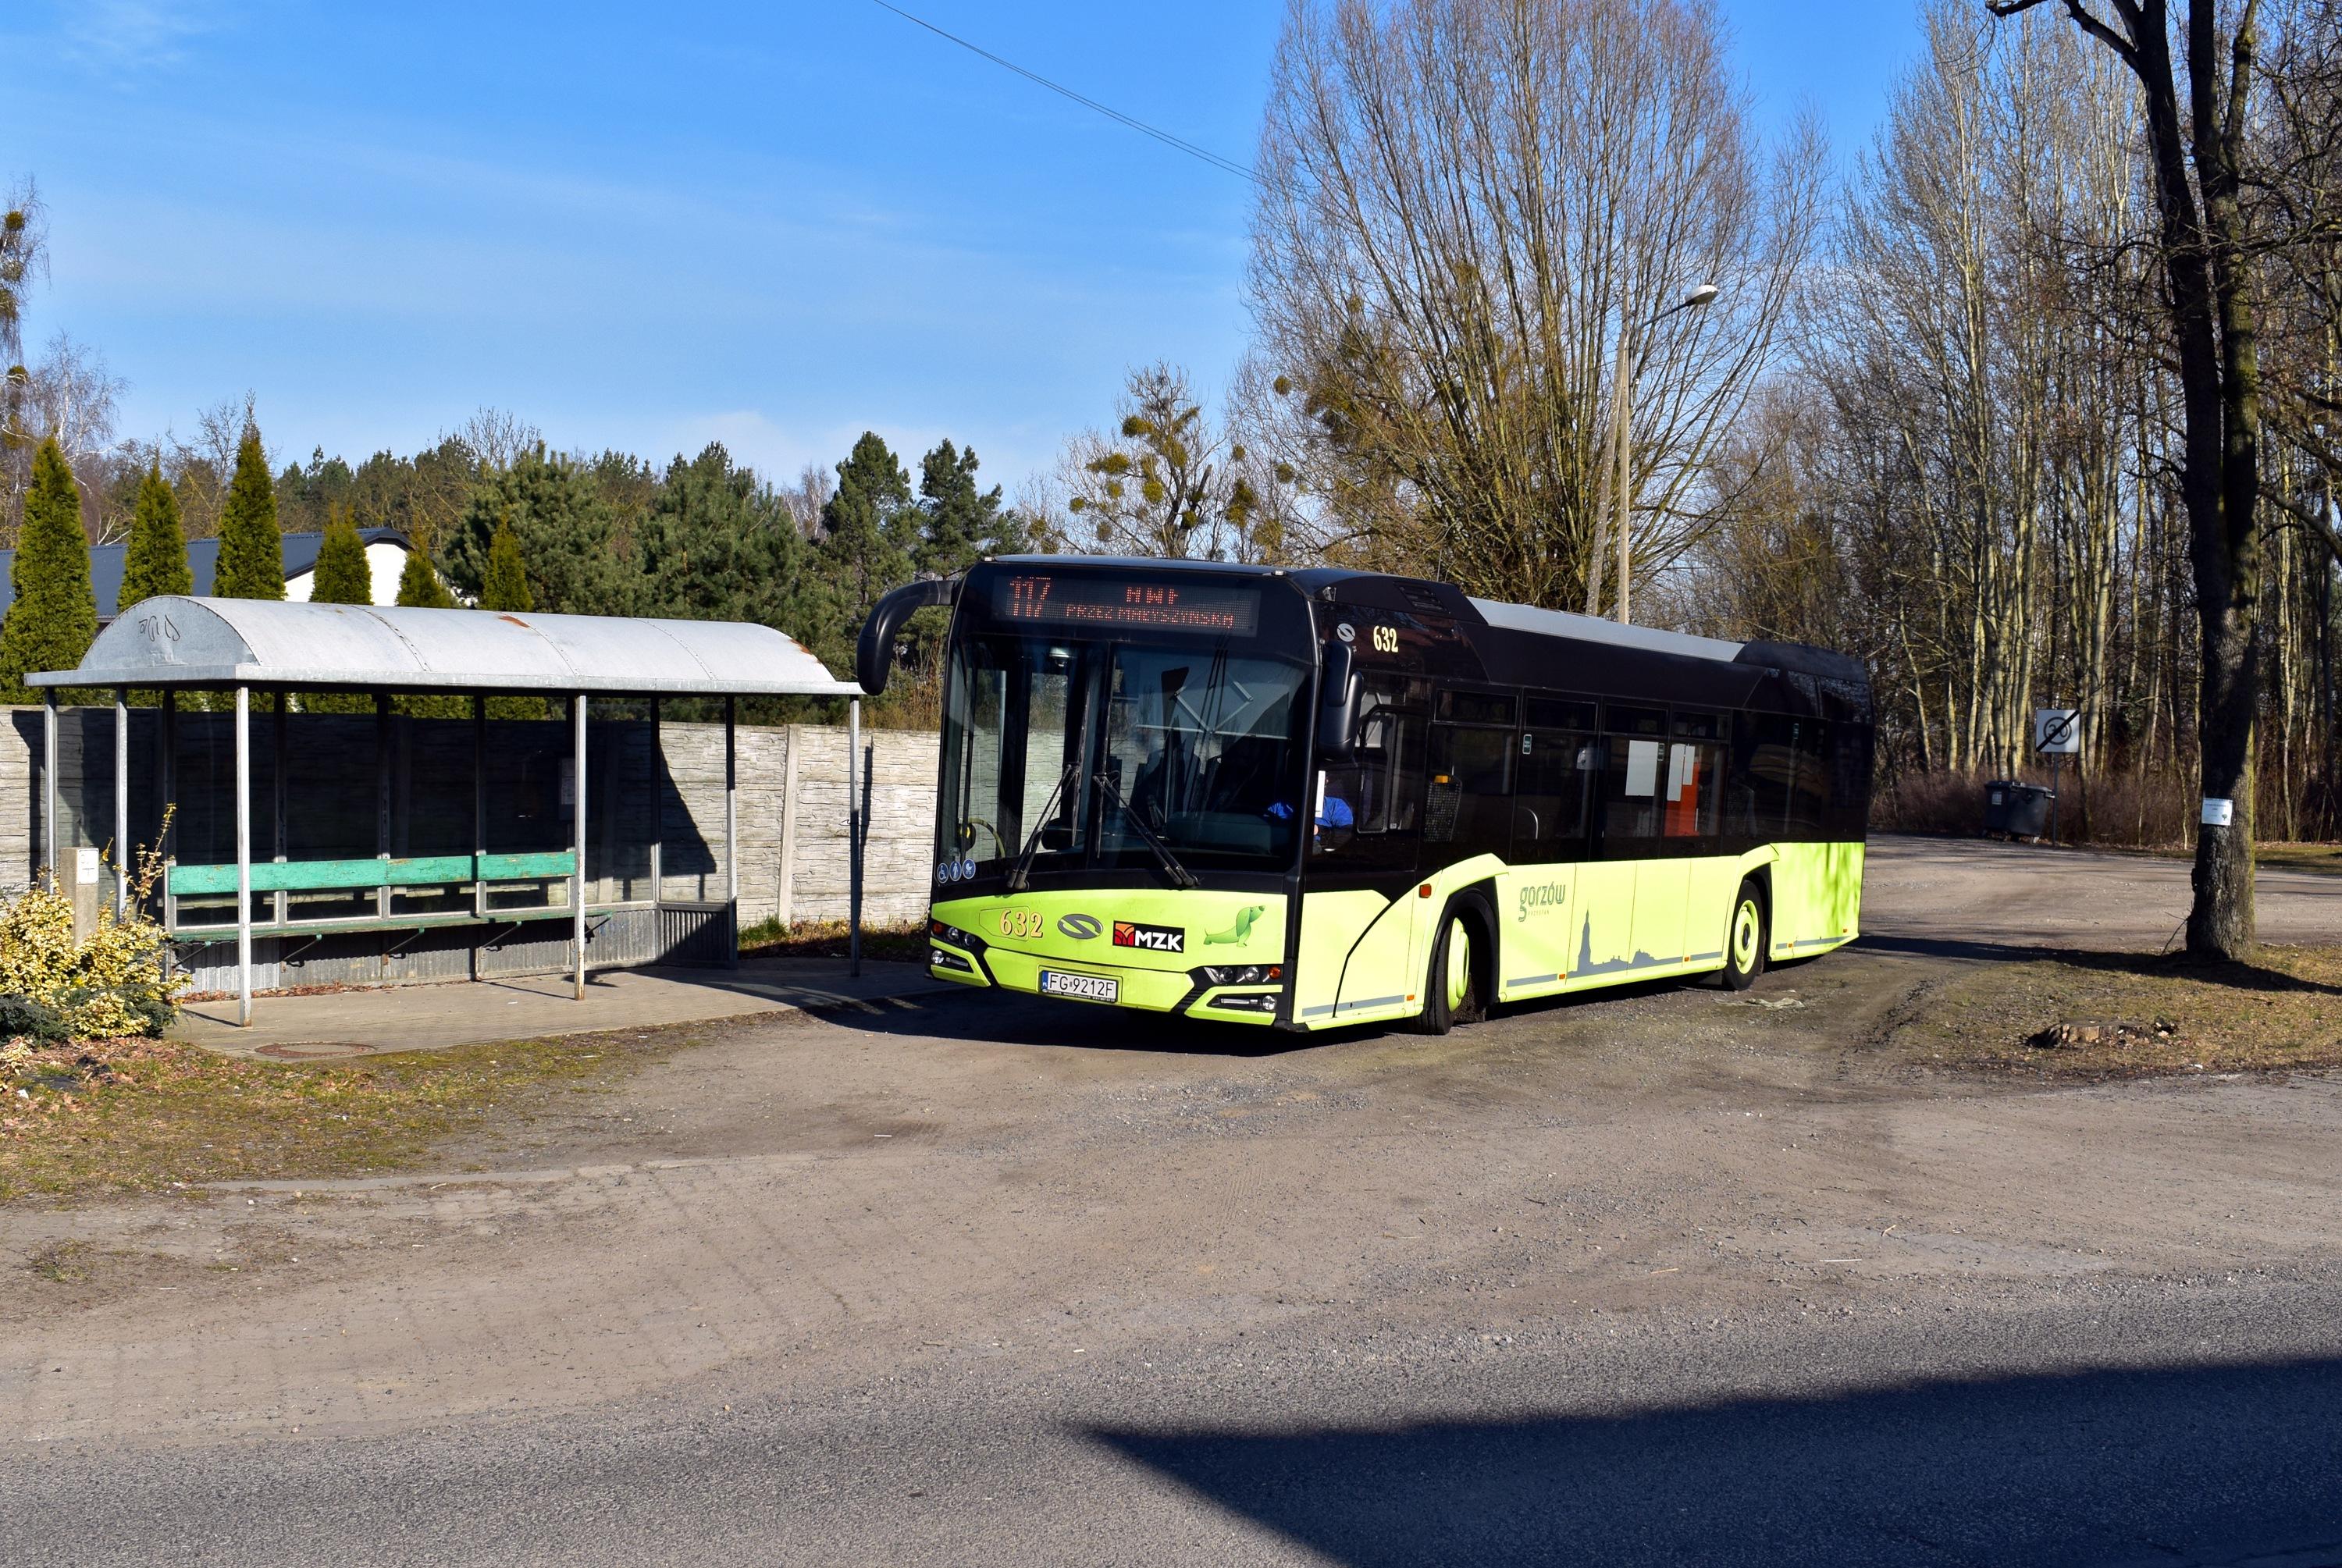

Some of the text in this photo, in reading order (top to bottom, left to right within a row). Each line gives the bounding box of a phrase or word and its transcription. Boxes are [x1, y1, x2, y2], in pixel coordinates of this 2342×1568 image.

[1009, 576, 1052, 617] 117
[1373, 625, 1399, 652] 632
[1518, 880, 1566, 922] gorzów
[999, 909, 1043, 938] 632
[1134, 930, 1183, 951] MZK
[1049, 974, 1069, 990] FG
[1073, 977, 1114, 997] 9212F
